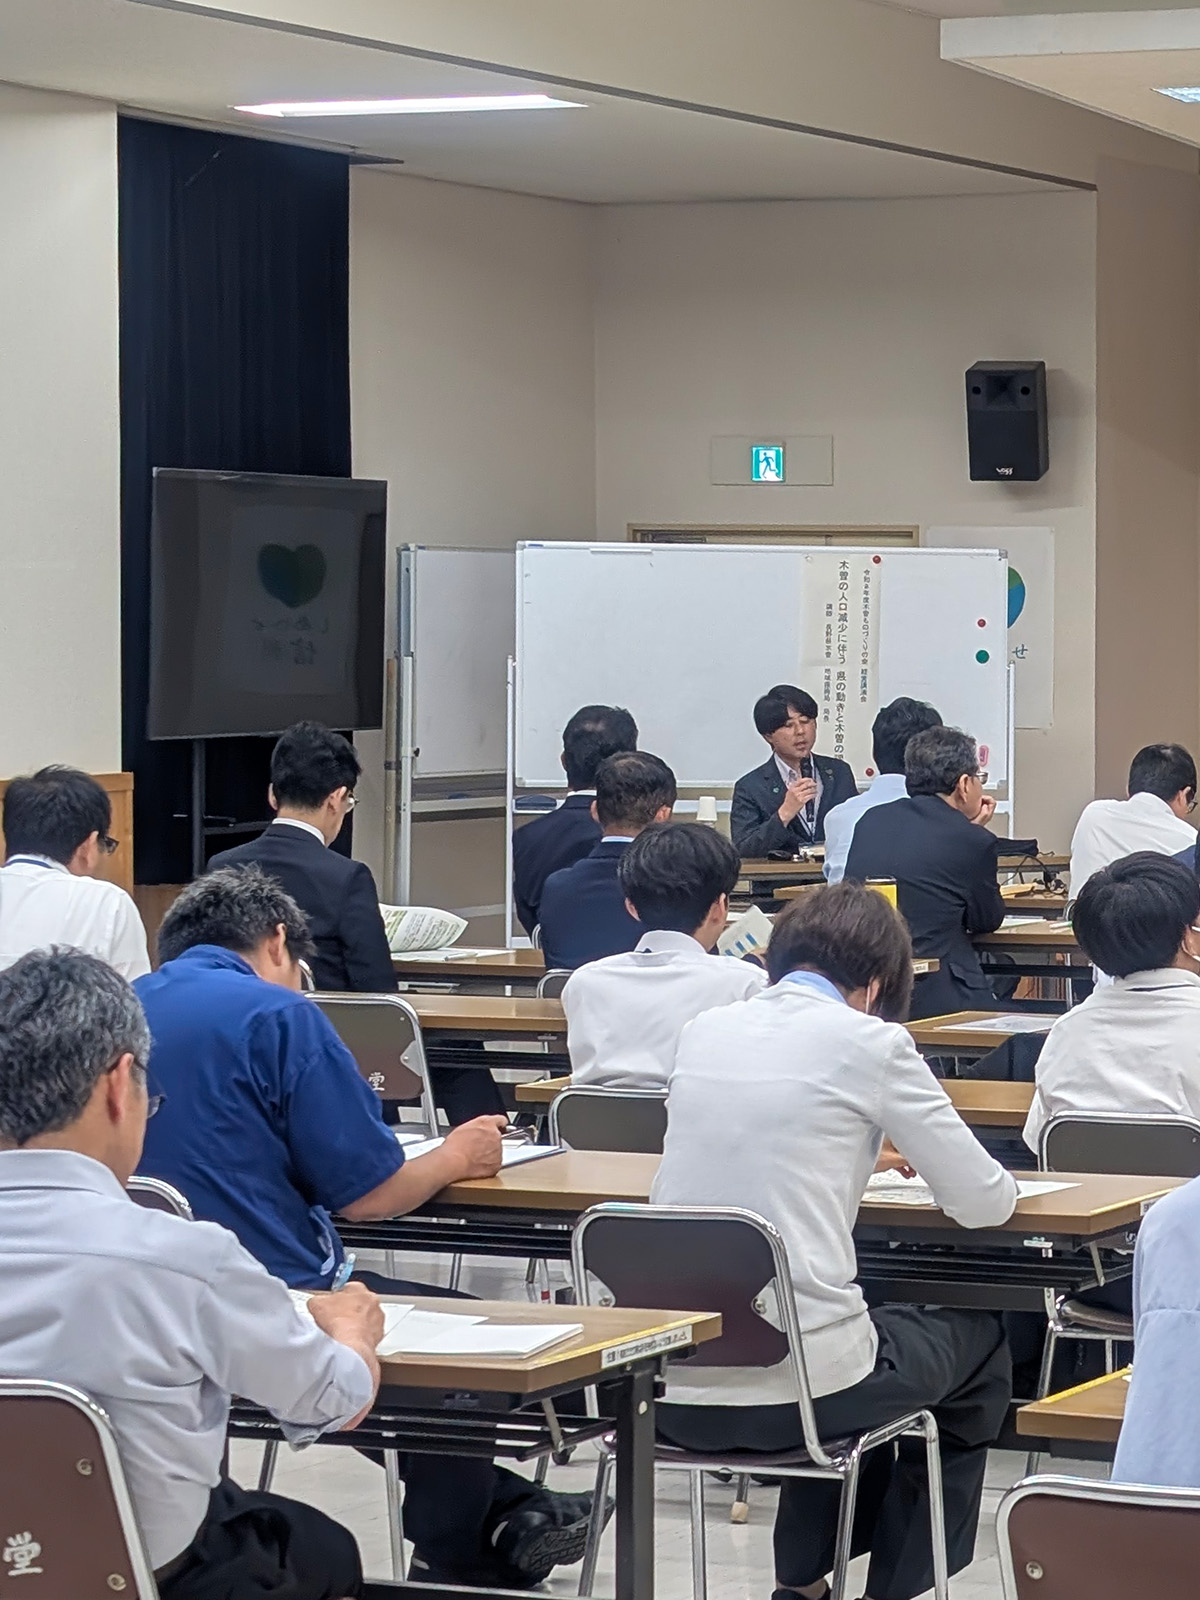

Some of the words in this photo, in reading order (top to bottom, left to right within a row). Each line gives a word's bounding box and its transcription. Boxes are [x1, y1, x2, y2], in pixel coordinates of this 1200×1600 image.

[837, 560, 850, 665] 木曽の人口減少に伴う
[1012, 643, 1028, 659] せ
